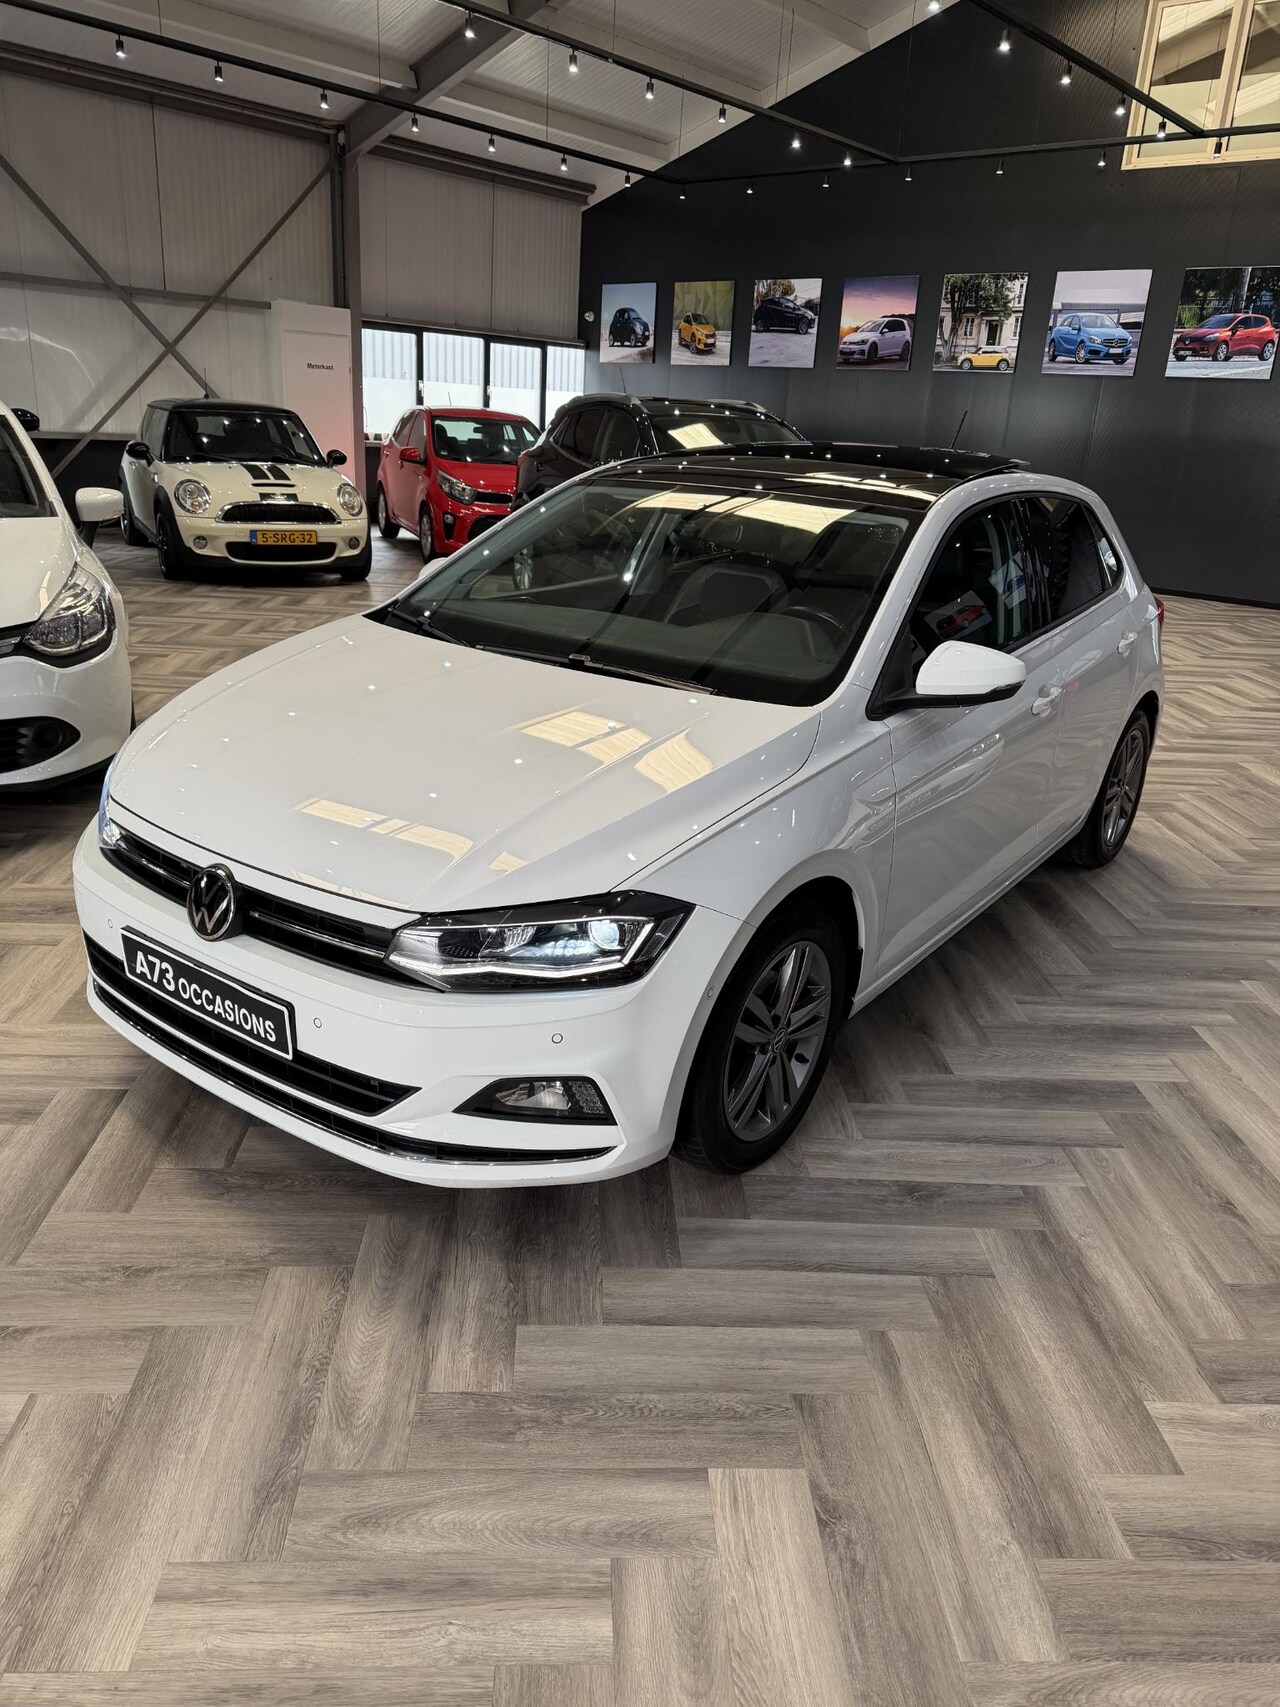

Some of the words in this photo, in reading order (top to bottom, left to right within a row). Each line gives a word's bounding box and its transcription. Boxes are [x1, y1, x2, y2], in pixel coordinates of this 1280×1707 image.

[306, 362, 334, 371] Meterkast
[261, 532, 313, 544] 5-SRG-32
[135, 950, 176, 992] A73
[178, 977, 277, 1043] OCCASIONS
